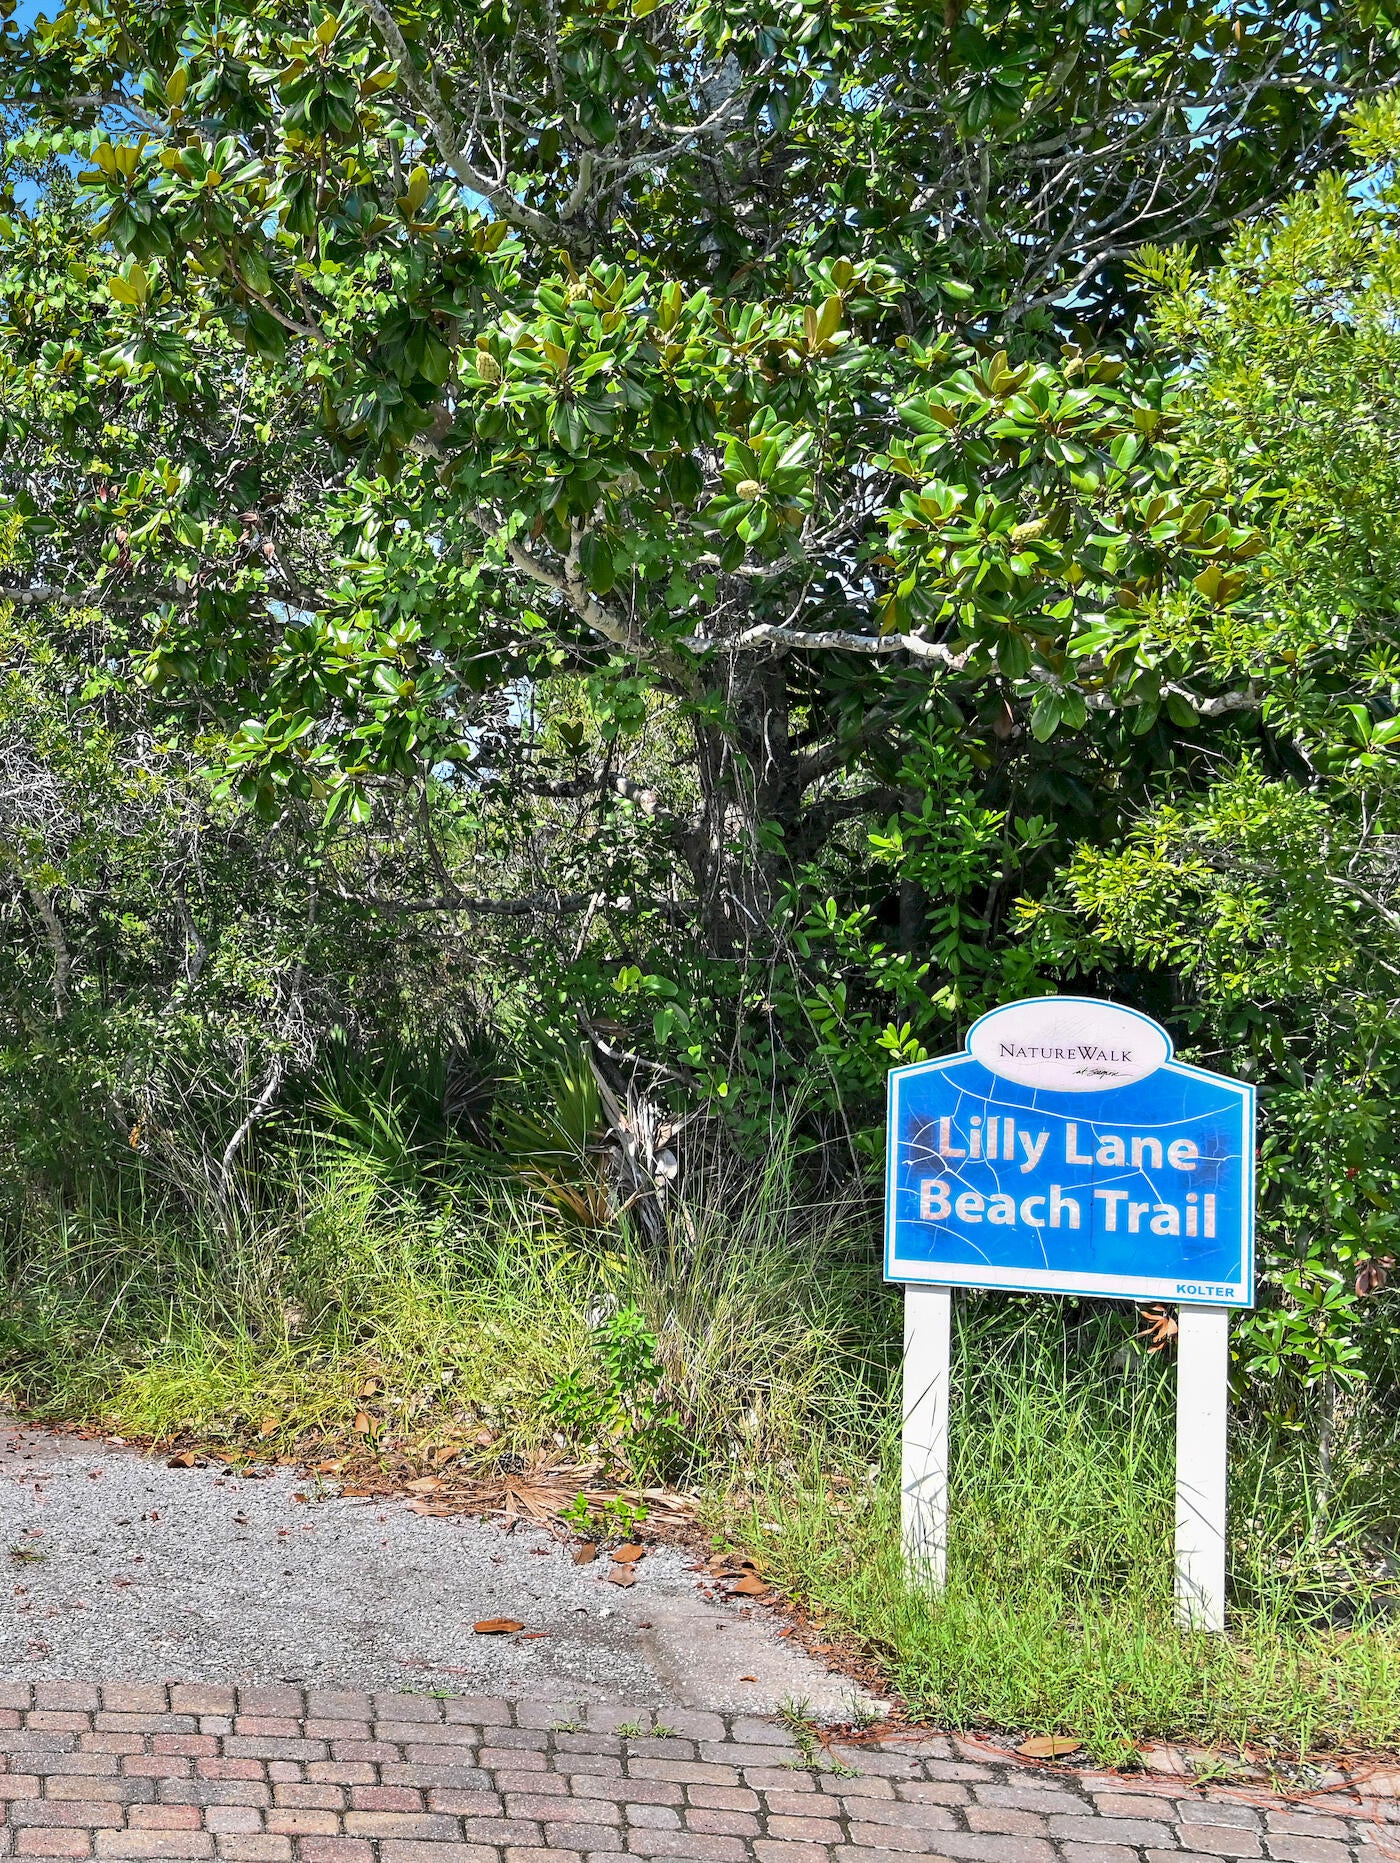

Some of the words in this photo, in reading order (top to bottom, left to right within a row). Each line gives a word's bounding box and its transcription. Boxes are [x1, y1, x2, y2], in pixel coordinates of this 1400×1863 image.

[938, 1115, 1050, 1174] Lilly
[1065, 1123, 1200, 1174] Lane
[919, 1178, 1081, 1230] Beach
[1094, 1188, 1217, 1239] Trail
[1176, 1284, 1235, 1298] KOLTER
